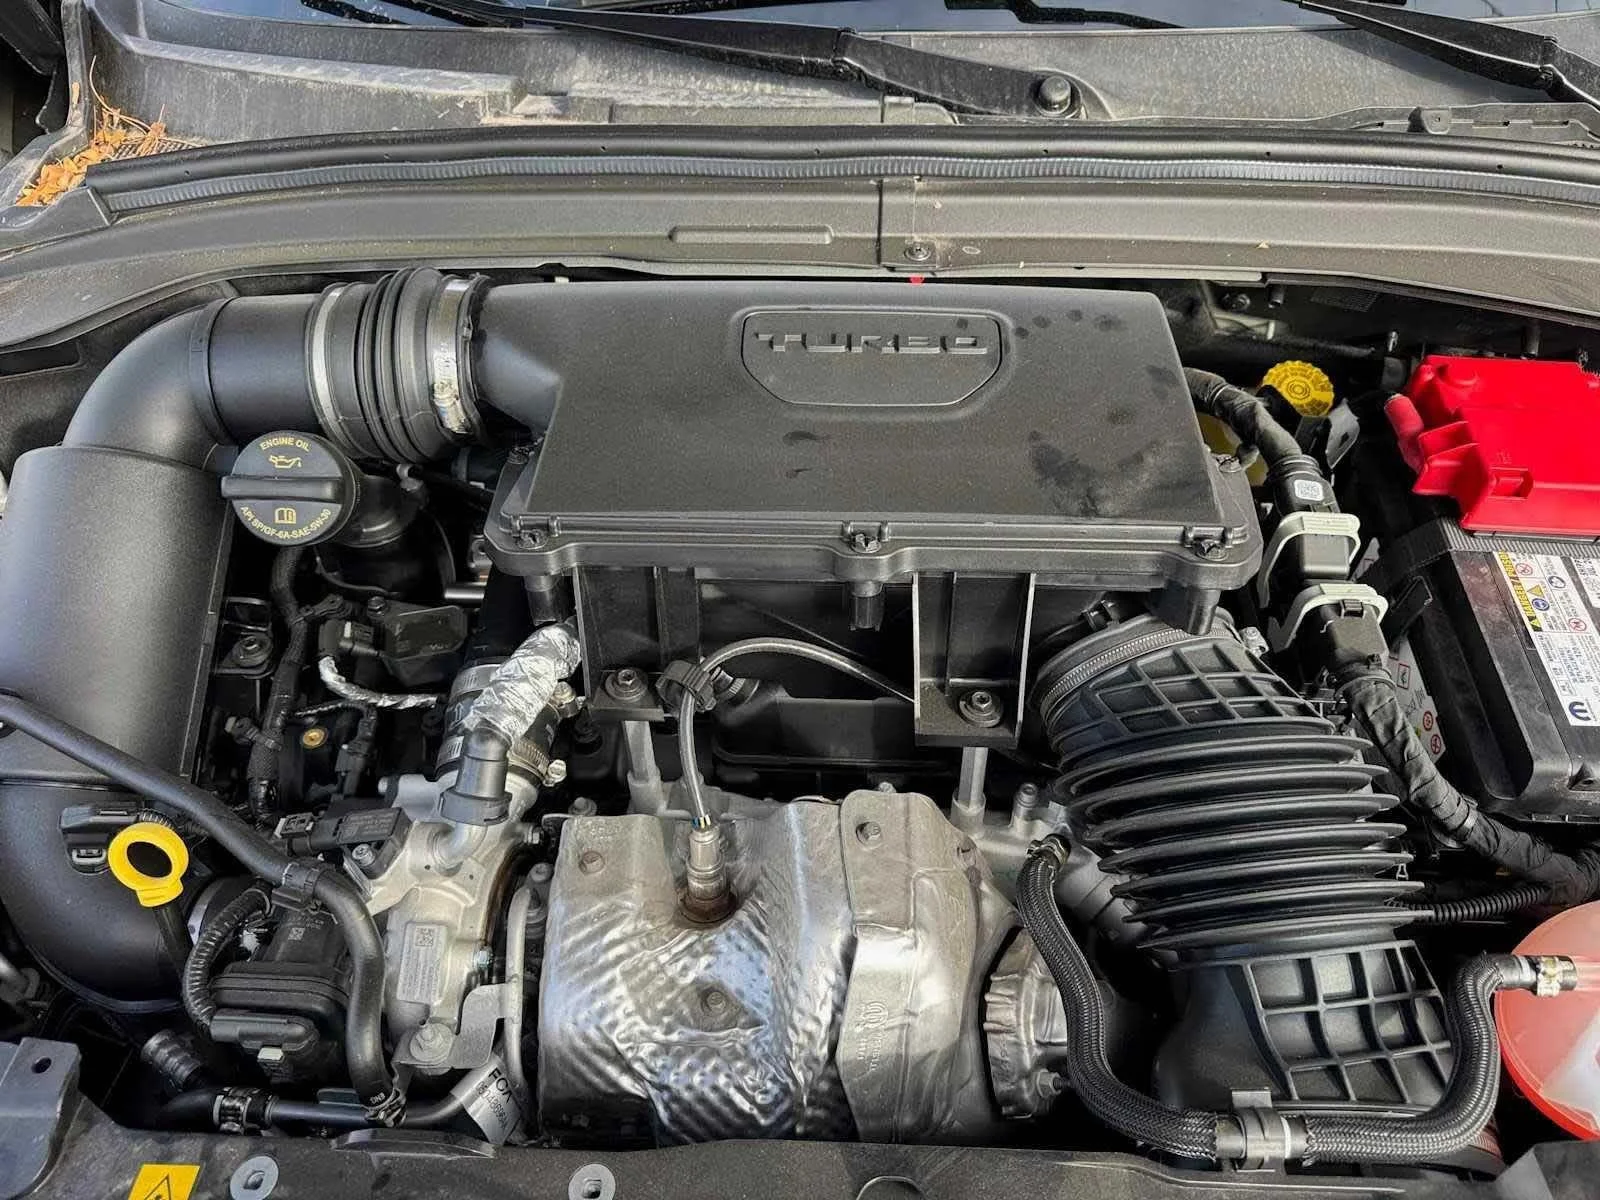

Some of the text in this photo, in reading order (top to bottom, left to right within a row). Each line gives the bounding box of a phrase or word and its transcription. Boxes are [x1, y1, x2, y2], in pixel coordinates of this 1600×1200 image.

[754, 332, 988, 355] TURBO
[260, 436, 312, 453] ENGINE OIL
[240, 505, 252, 522] API
[488, 1067, 512, 1104] FCA
